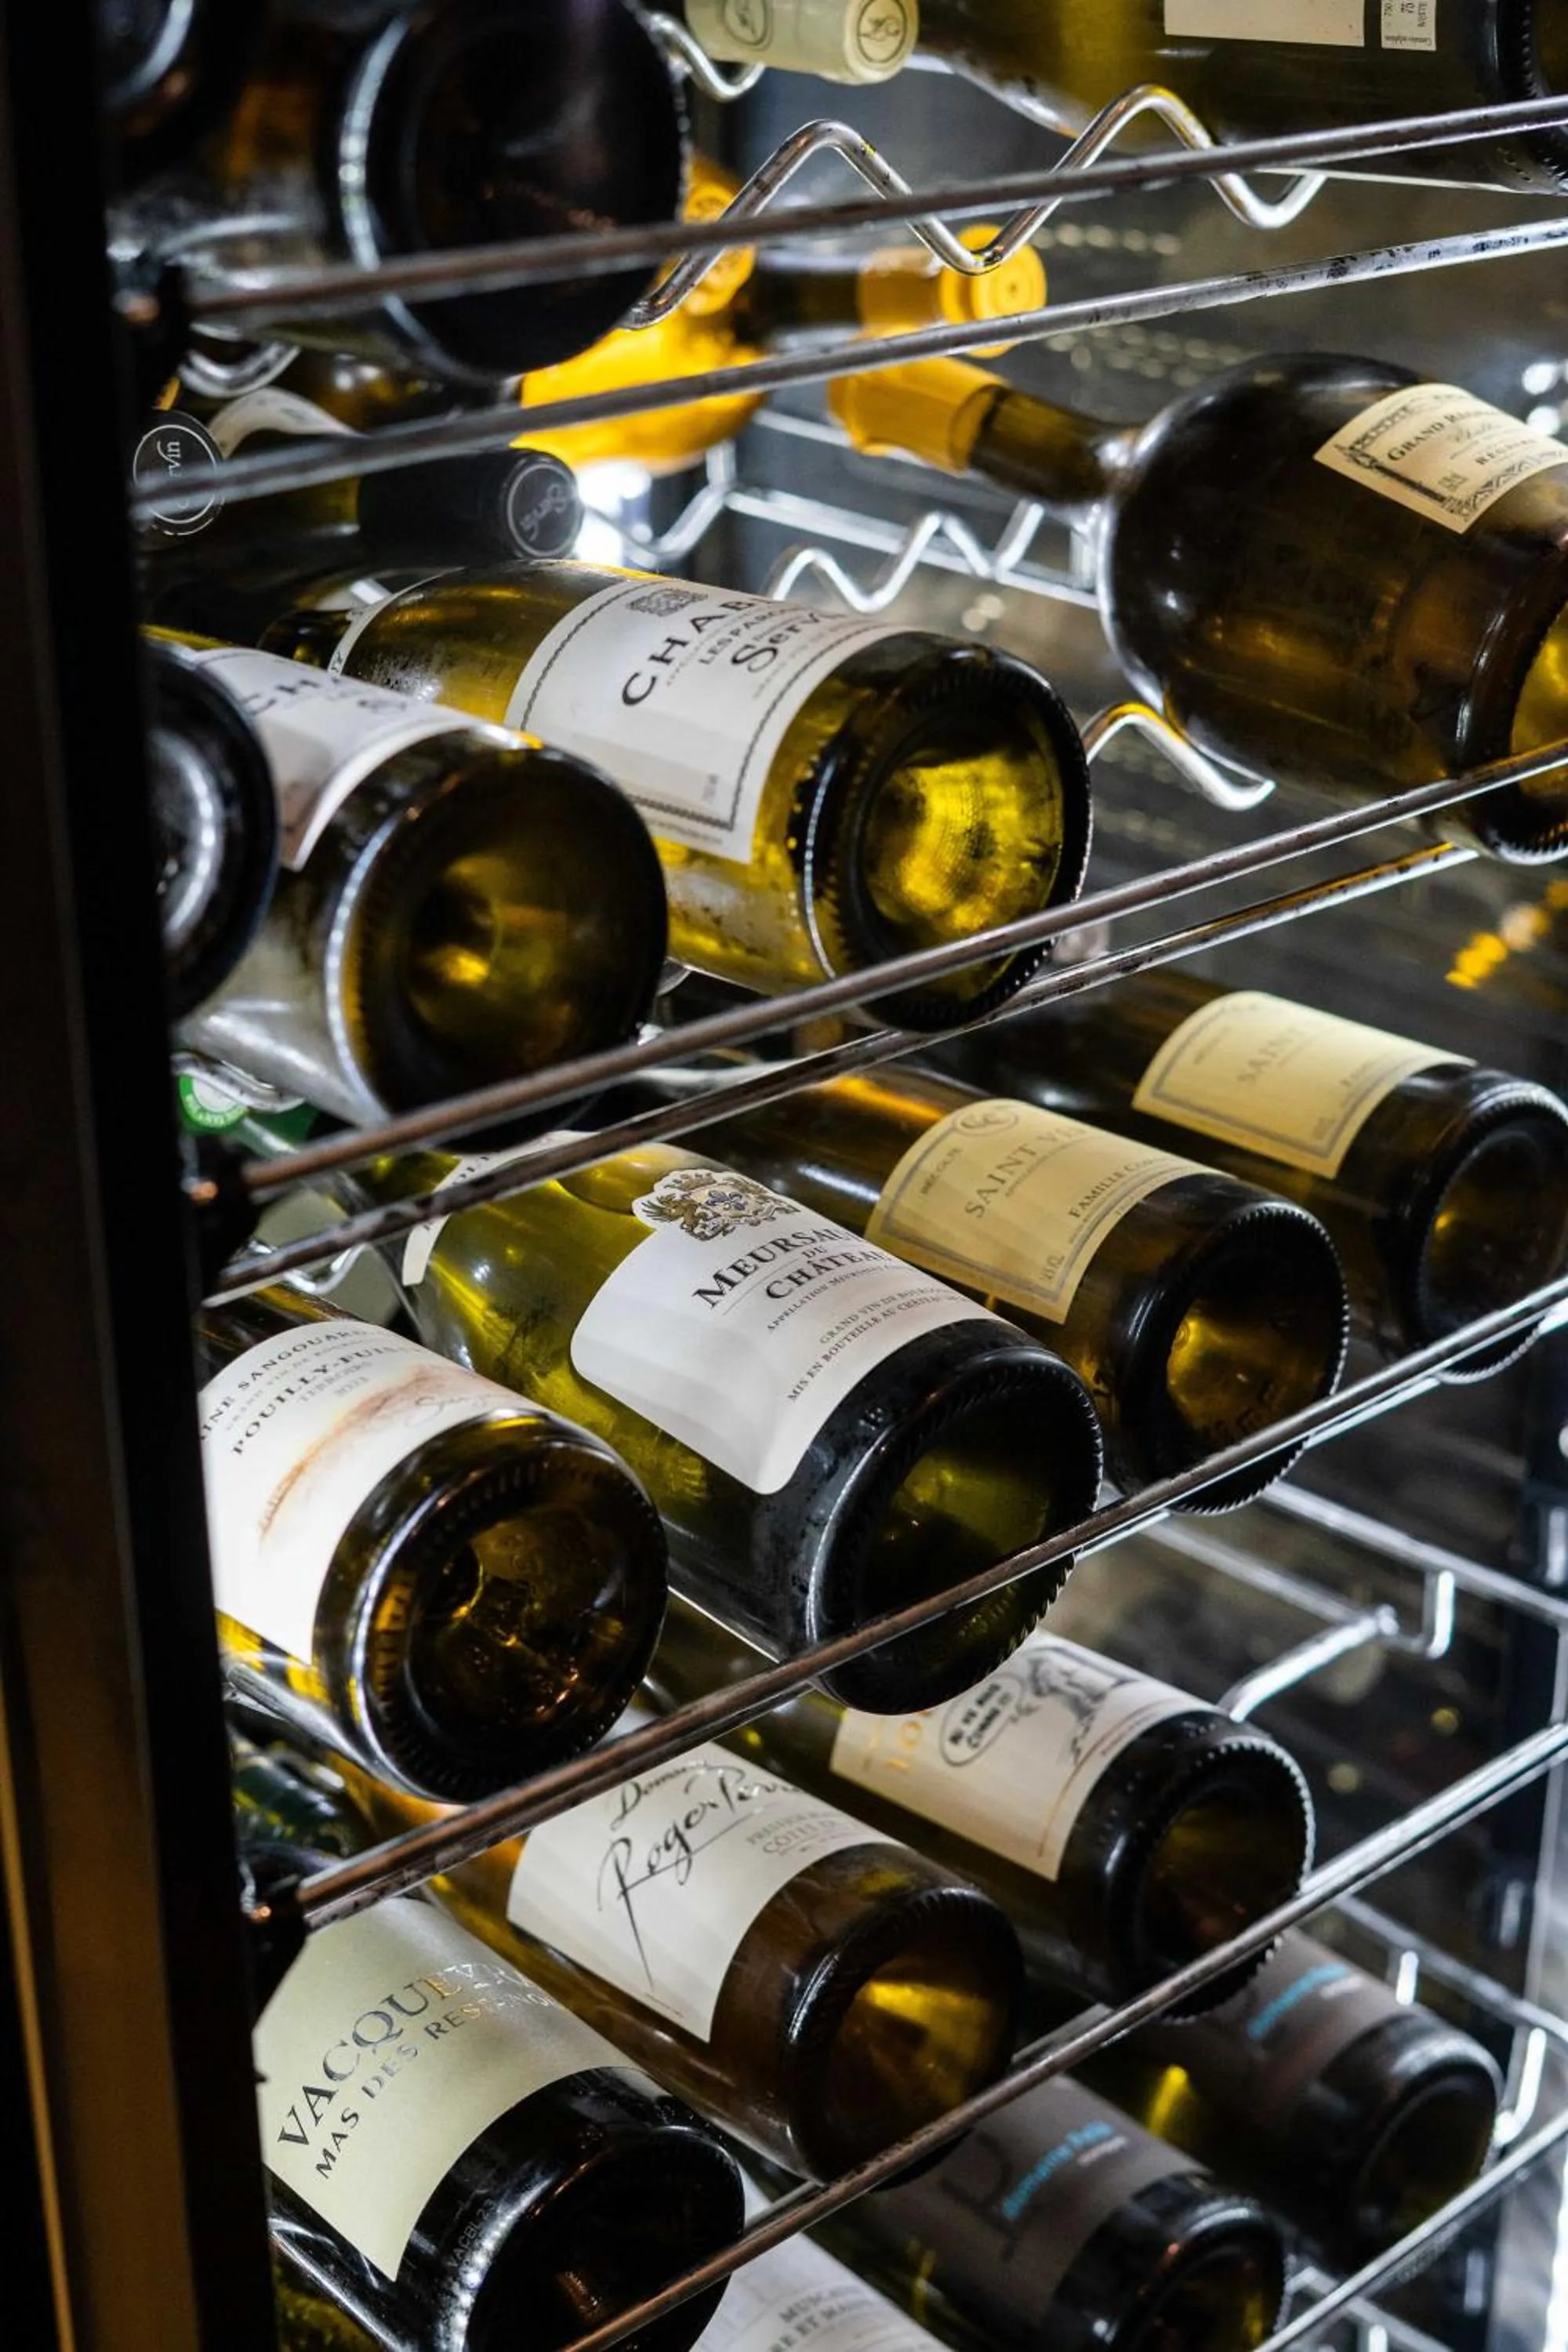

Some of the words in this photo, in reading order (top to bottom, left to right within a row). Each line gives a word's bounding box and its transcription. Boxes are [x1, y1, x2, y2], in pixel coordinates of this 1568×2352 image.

[1387, 421, 1445, 461] GRAND
[622, 597, 784, 706] CHAB
[731, 612, 847, 673] Serv
[965, 1143, 1036, 1218] SAINT
[1069, 1171, 1126, 1218] FAMILLE
[787, 1379, 809, 1401] MIS
[807, 1362, 823, 1379] EN
[822, 1314, 881, 1362] BOUTEILLE
[820, 1313, 859, 1344] GRAND
[858, 1299, 881, 1315] VIN
[231, 1345, 421, 1456] POUILLY-FUI
[597, 1798, 720, 1990] Roger
[278, 1962, 535, 2148] VACQUE
[315, 2107, 360, 2180] MAS
[361, 2042, 419, 2100] DES
